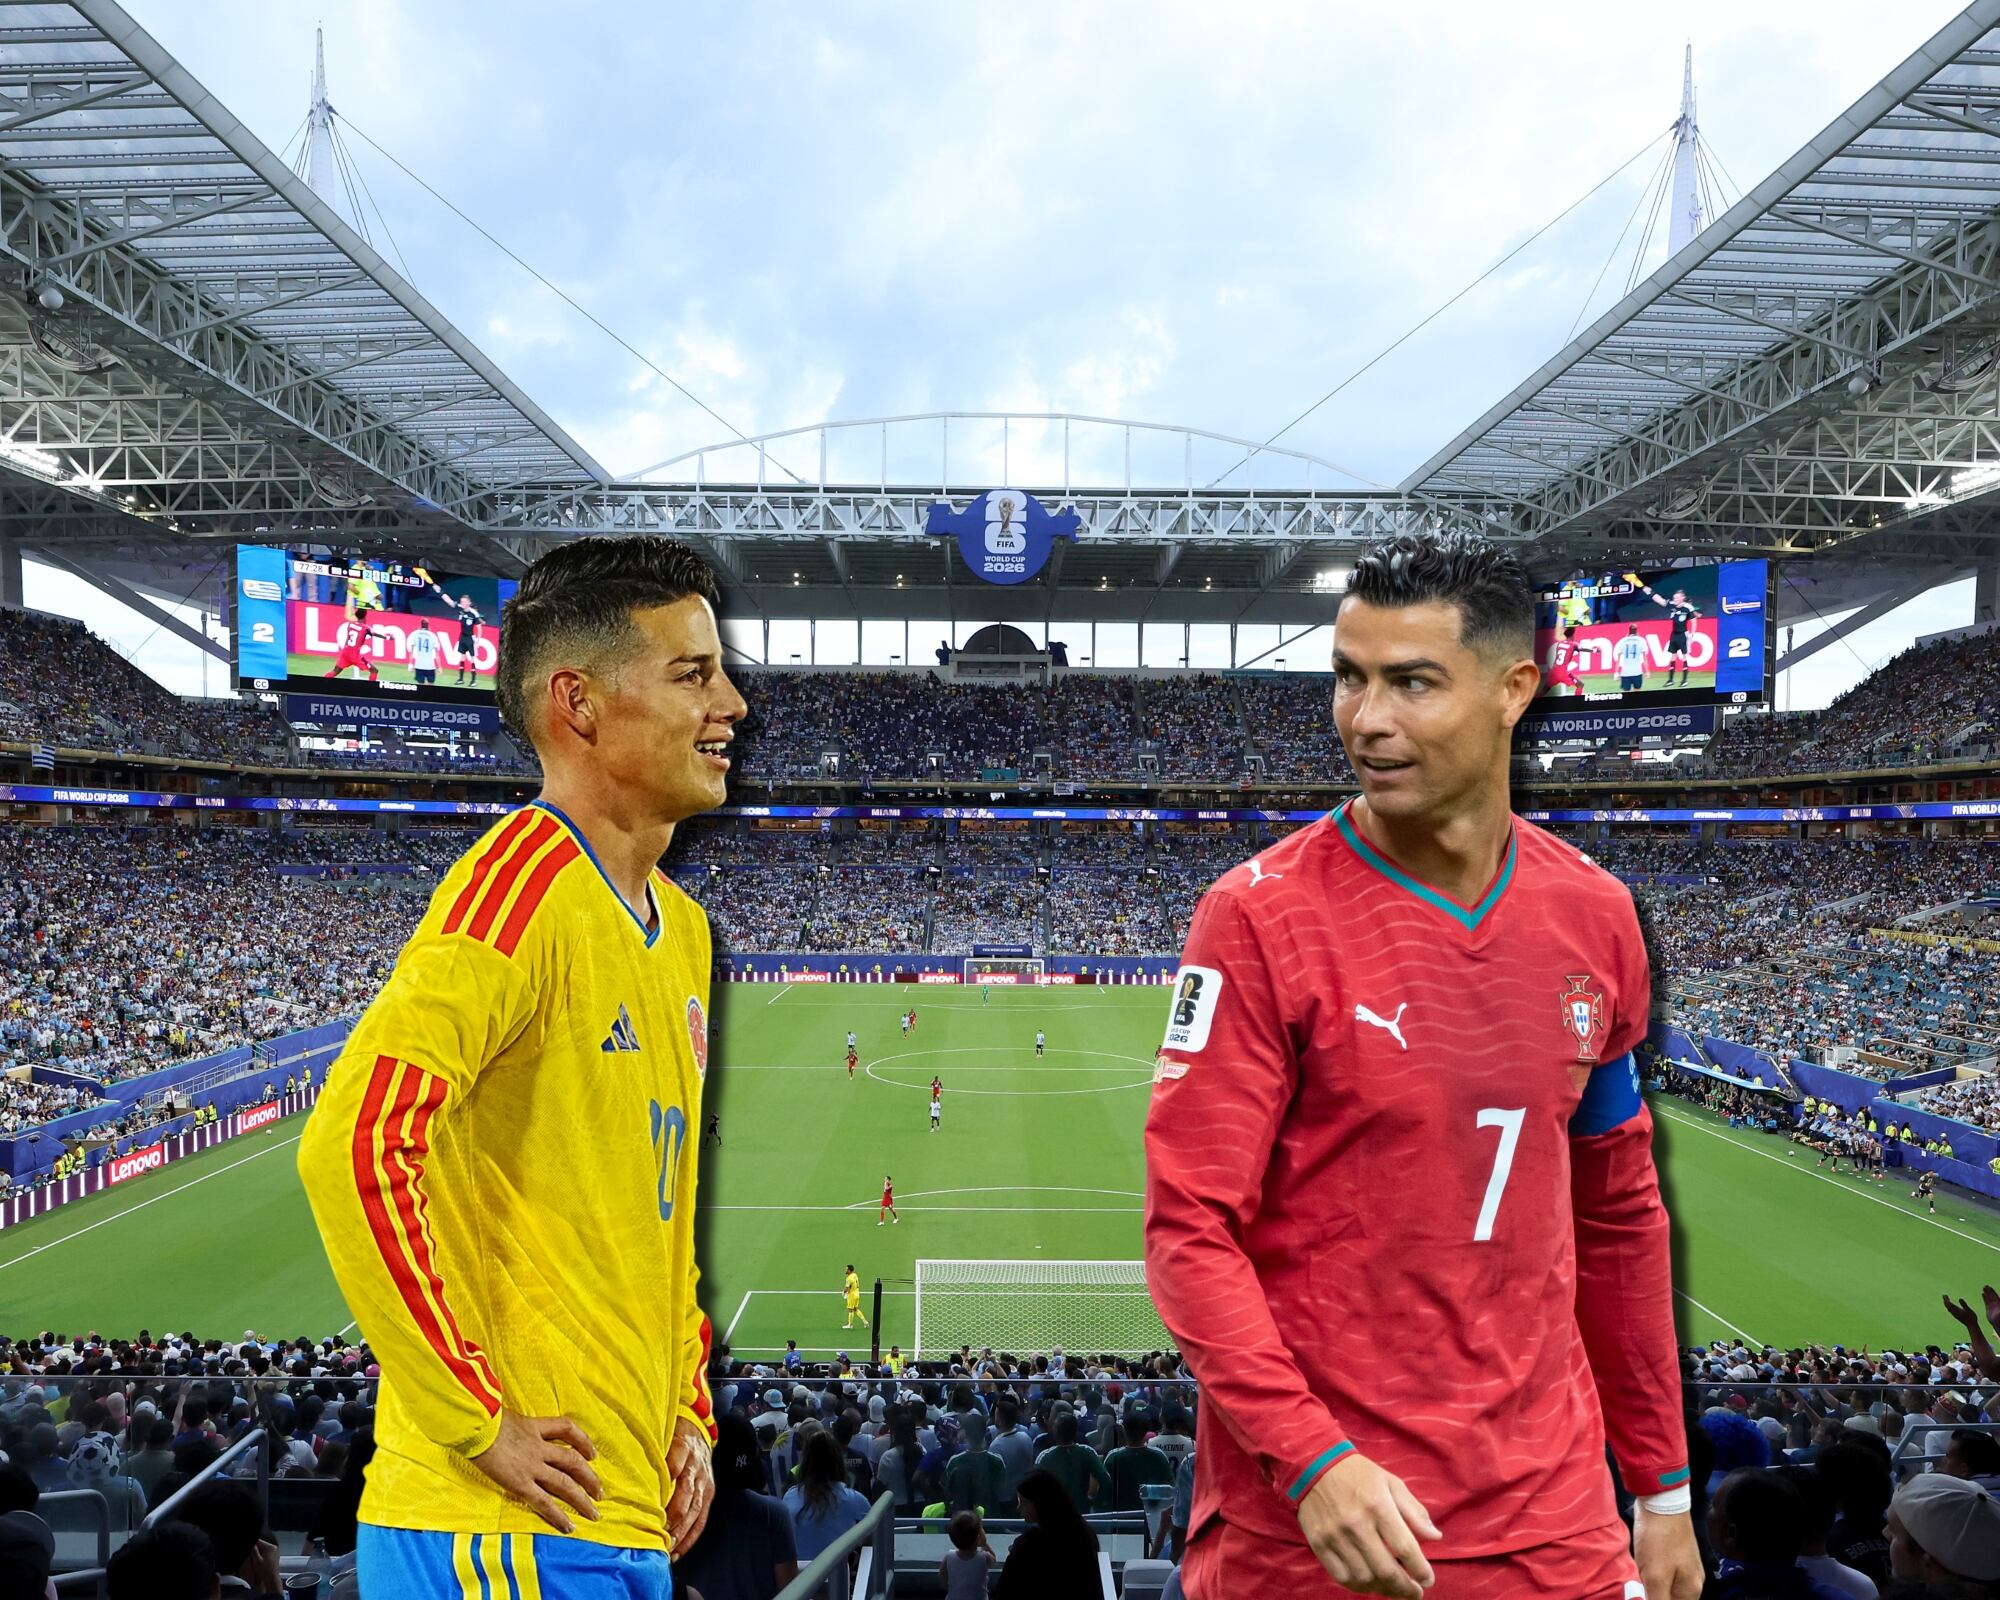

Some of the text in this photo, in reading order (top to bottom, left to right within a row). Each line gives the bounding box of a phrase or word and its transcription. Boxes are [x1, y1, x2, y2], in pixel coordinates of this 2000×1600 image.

[996, 540, 1015, 549] FIFA
[984, 555, 1010, 563] WORLD
[299, 563, 323, 573] 77:28
[983, 562, 1026, 573] 2026
[252, 622, 275, 643] 2
[305, 607, 497, 670] Lenvo
[418, 637, 429, 651] 14
[1625, 643, 1637, 659] 14
[1728, 638, 1750, 658] 2
[255, 680, 268, 689] CC
[379, 680, 418, 691] Hisense
[1584, 691, 1623, 702] Hisense
[1733, 693, 1745, 701] CC
[310, 703, 481, 725] FIFA WORLD CUP 2026
[1521, 714, 1692, 733] FIFA WORLD CUP 2026
[53, 790, 69, 800] FIFA
[69, 791, 94, 802] WORLD
[94, 792, 107, 802] CUP
[871, 808, 900, 816] MIAMI
[1198, 811, 1227, 819] MIAMI
[1952, 805, 1968, 815] FIFA
[1969, 804, 1997, 814] WORLD
[789, 973, 825, 981] Lenovo
[919, 974, 959, 983] Lenovo
[977, 974, 1016, 983] Lenovo
[1168, 1034, 1189, 1043] 026
[242, 1105, 277, 1130] Lenovo
[110, 1150, 161, 1182] Lenovo
[1472, 1106, 1527, 1241] 7
